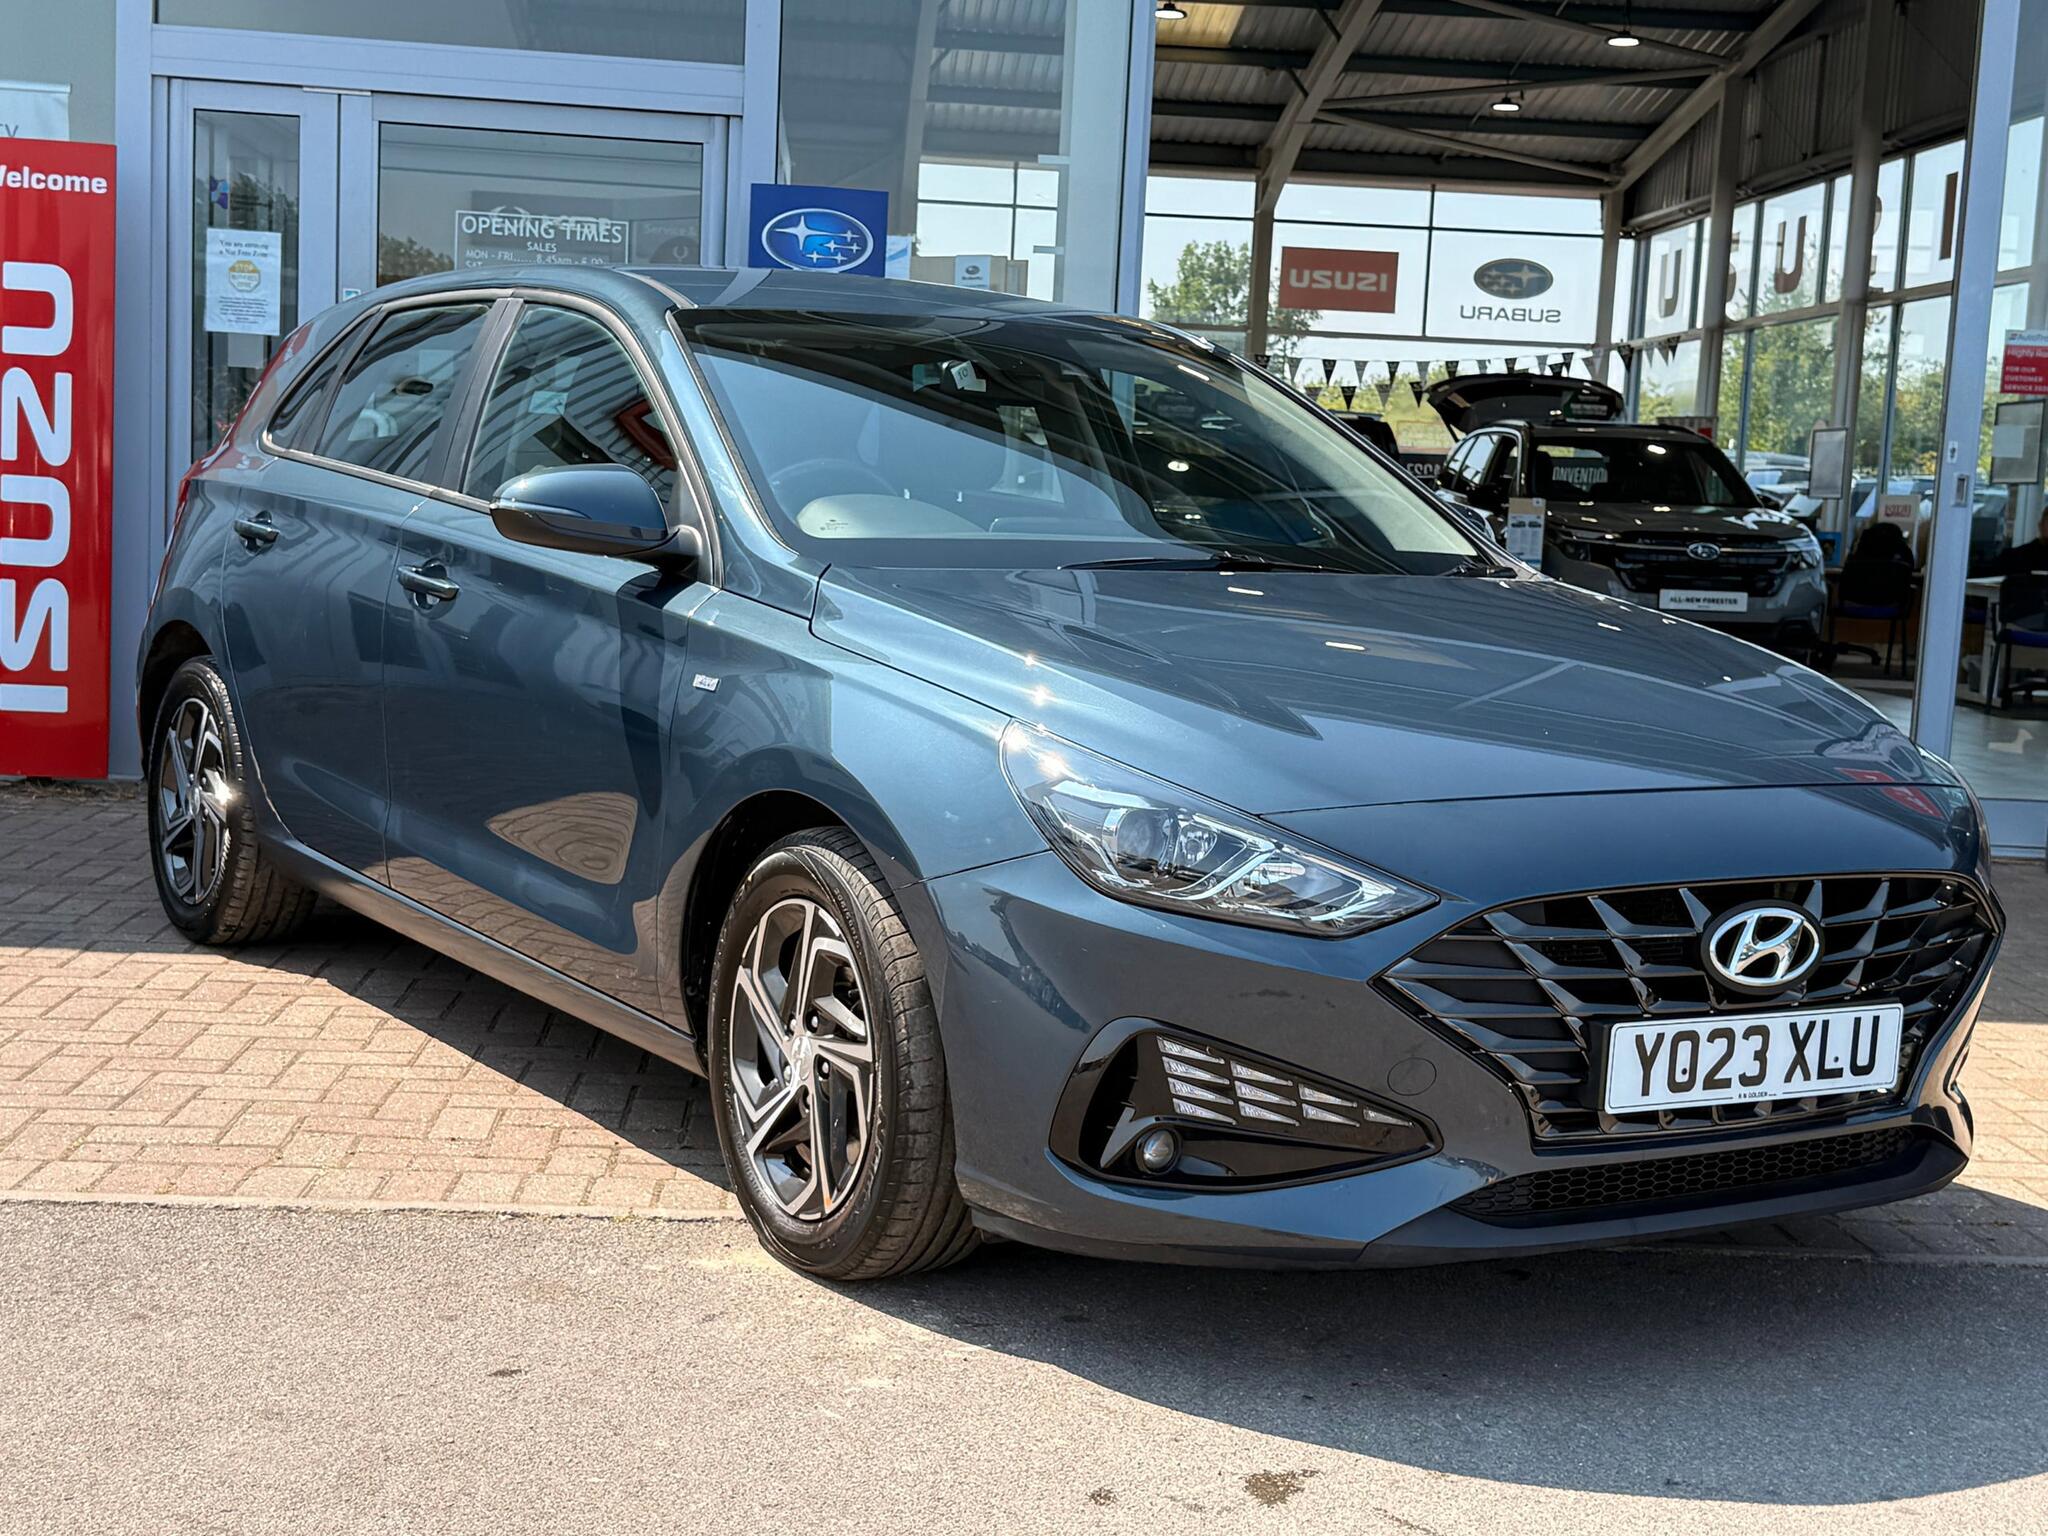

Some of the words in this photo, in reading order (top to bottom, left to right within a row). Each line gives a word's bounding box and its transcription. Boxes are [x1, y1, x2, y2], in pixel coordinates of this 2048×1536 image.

[461, 215, 555, 240] OPENING
[564, 221, 622, 243] TIMES
[465, 249, 488, 259] MON
[526, 241, 557, 253] SALES
[0, 261, 73, 713] ISUZU
[1635, 1025, 1770, 1097] YO23
[1783, 1015, 1881, 1084] XLU
